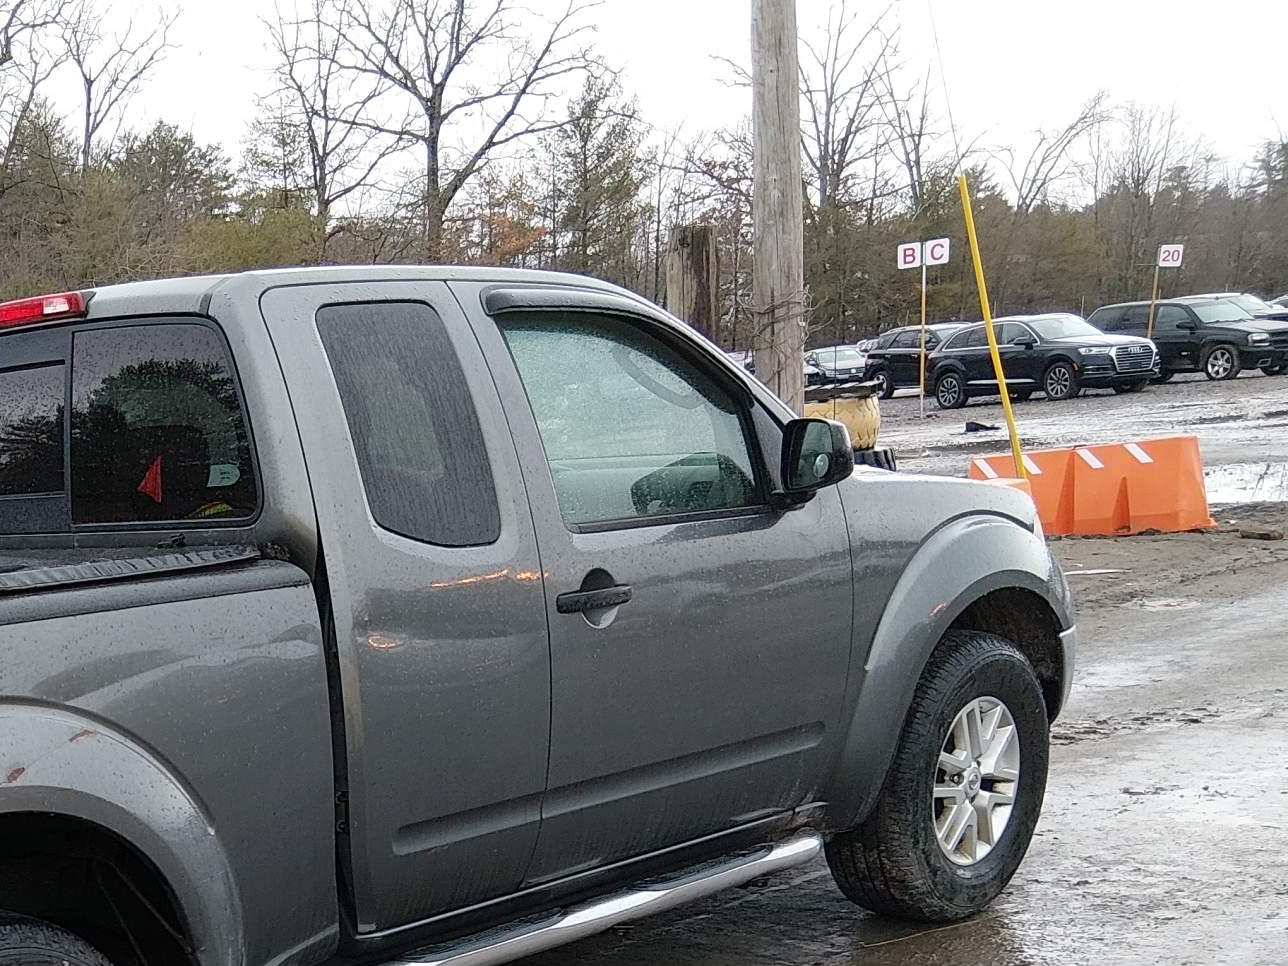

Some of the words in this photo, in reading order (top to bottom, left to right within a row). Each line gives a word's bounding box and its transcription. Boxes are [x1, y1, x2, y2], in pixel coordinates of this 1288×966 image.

[903, 247, 916, 265] B
[930, 243, 945, 261] C
[1162, 249, 1181, 262] 20
